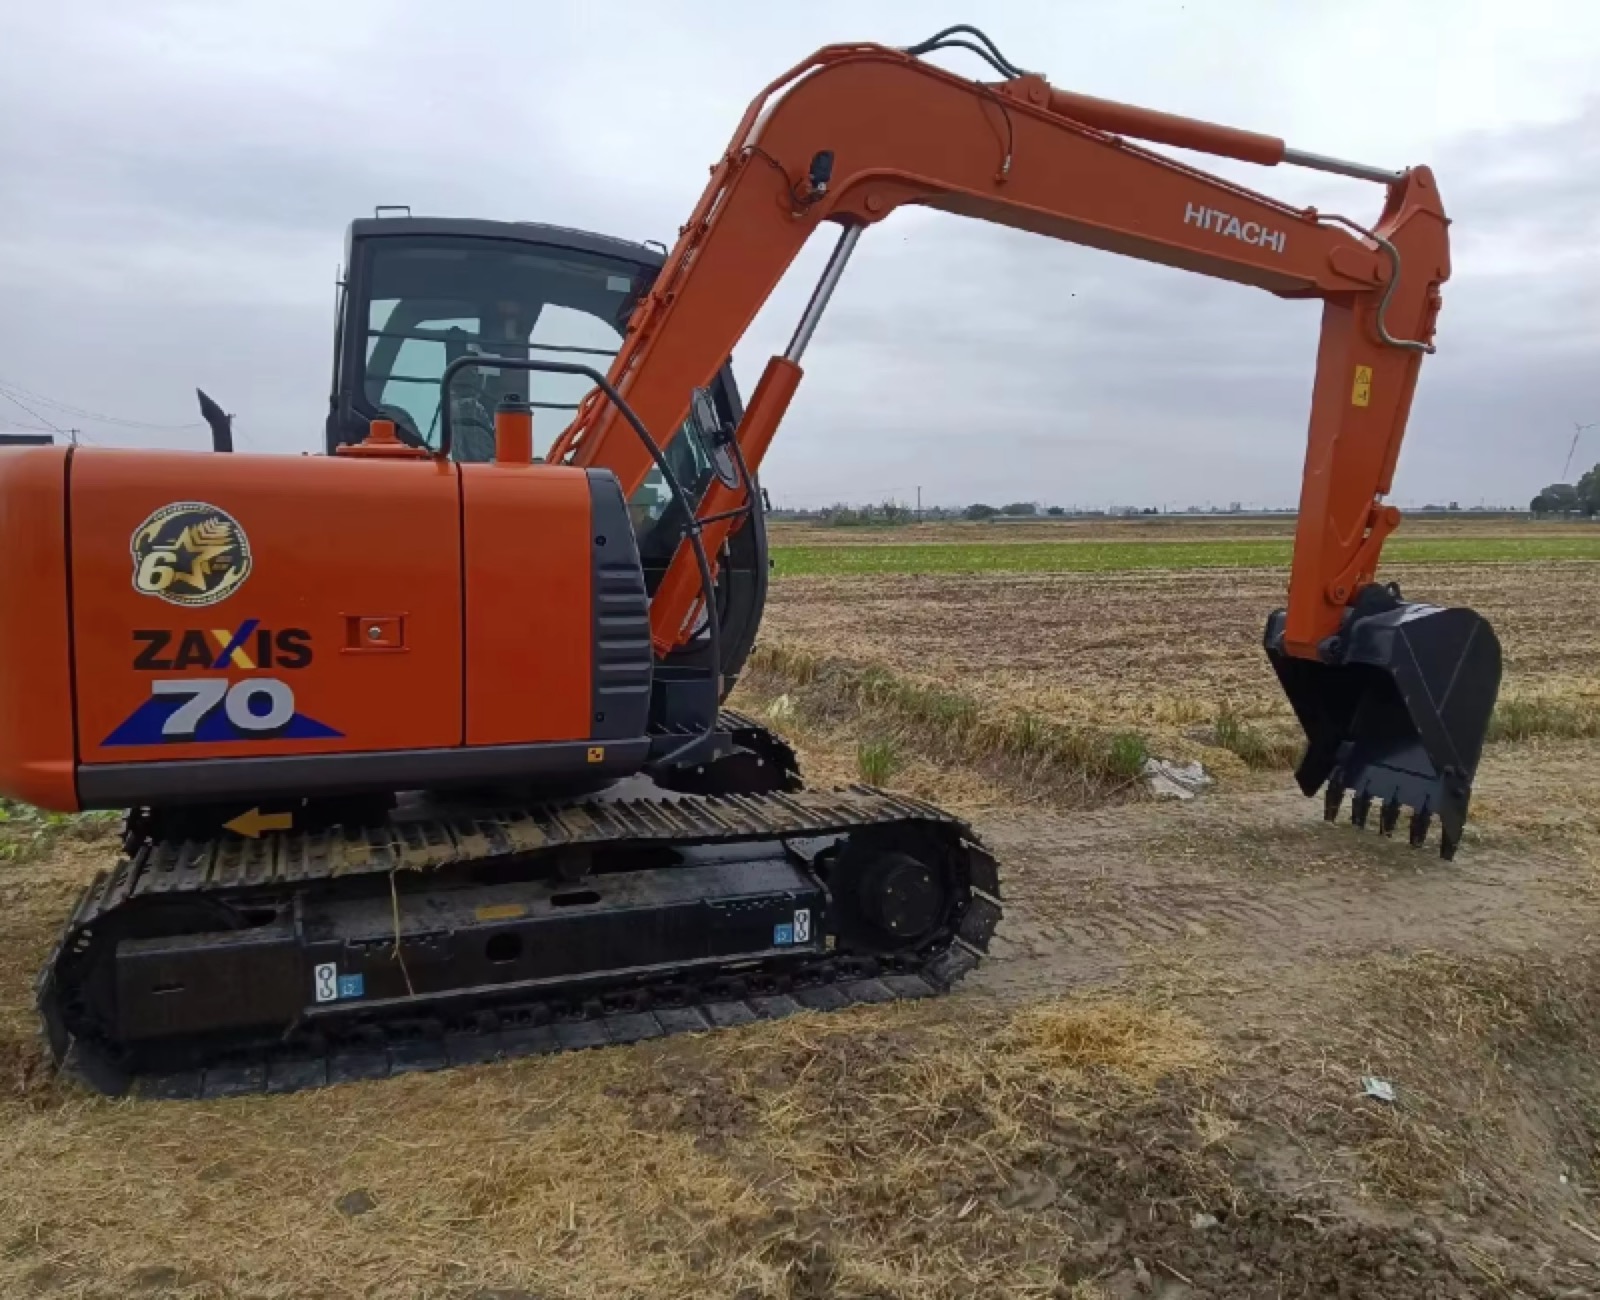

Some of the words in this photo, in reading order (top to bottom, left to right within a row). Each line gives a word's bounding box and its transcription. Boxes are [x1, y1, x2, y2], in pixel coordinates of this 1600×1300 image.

[1184, 202, 1287, 253] HITACHI
[131, 618, 314, 671] ZAXIS
[152, 677, 296, 738] 70
